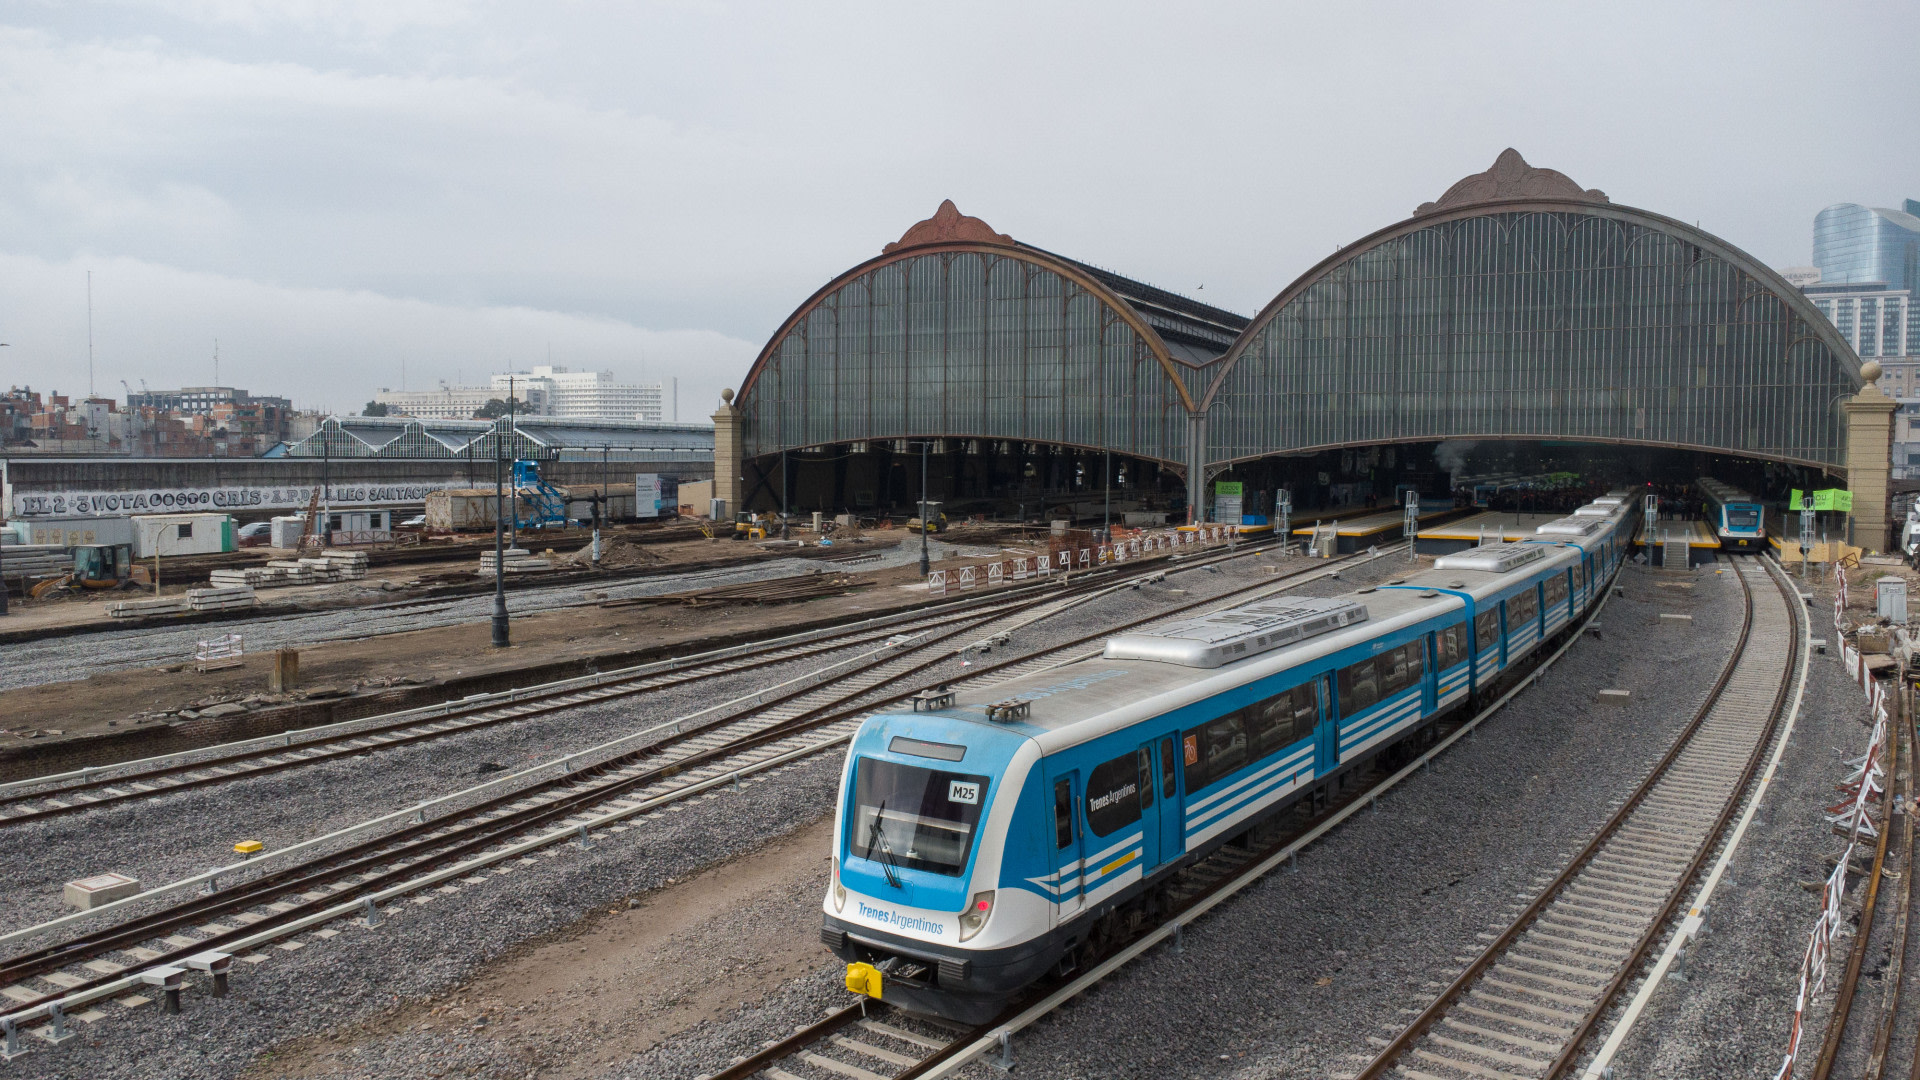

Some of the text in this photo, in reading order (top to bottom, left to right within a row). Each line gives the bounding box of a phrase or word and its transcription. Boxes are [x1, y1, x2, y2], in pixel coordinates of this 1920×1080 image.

[23, 496, 52, 514] EL
[92, 493, 148, 511] VOTA
[149, 492, 210, 506] LISTA
[337, 487, 366, 502] LEO
[952, 785, 975, 800] M25
[1089, 783, 1136, 812] Trenes Argentinos
[858, 902, 944, 935] Trenes Argentinos
